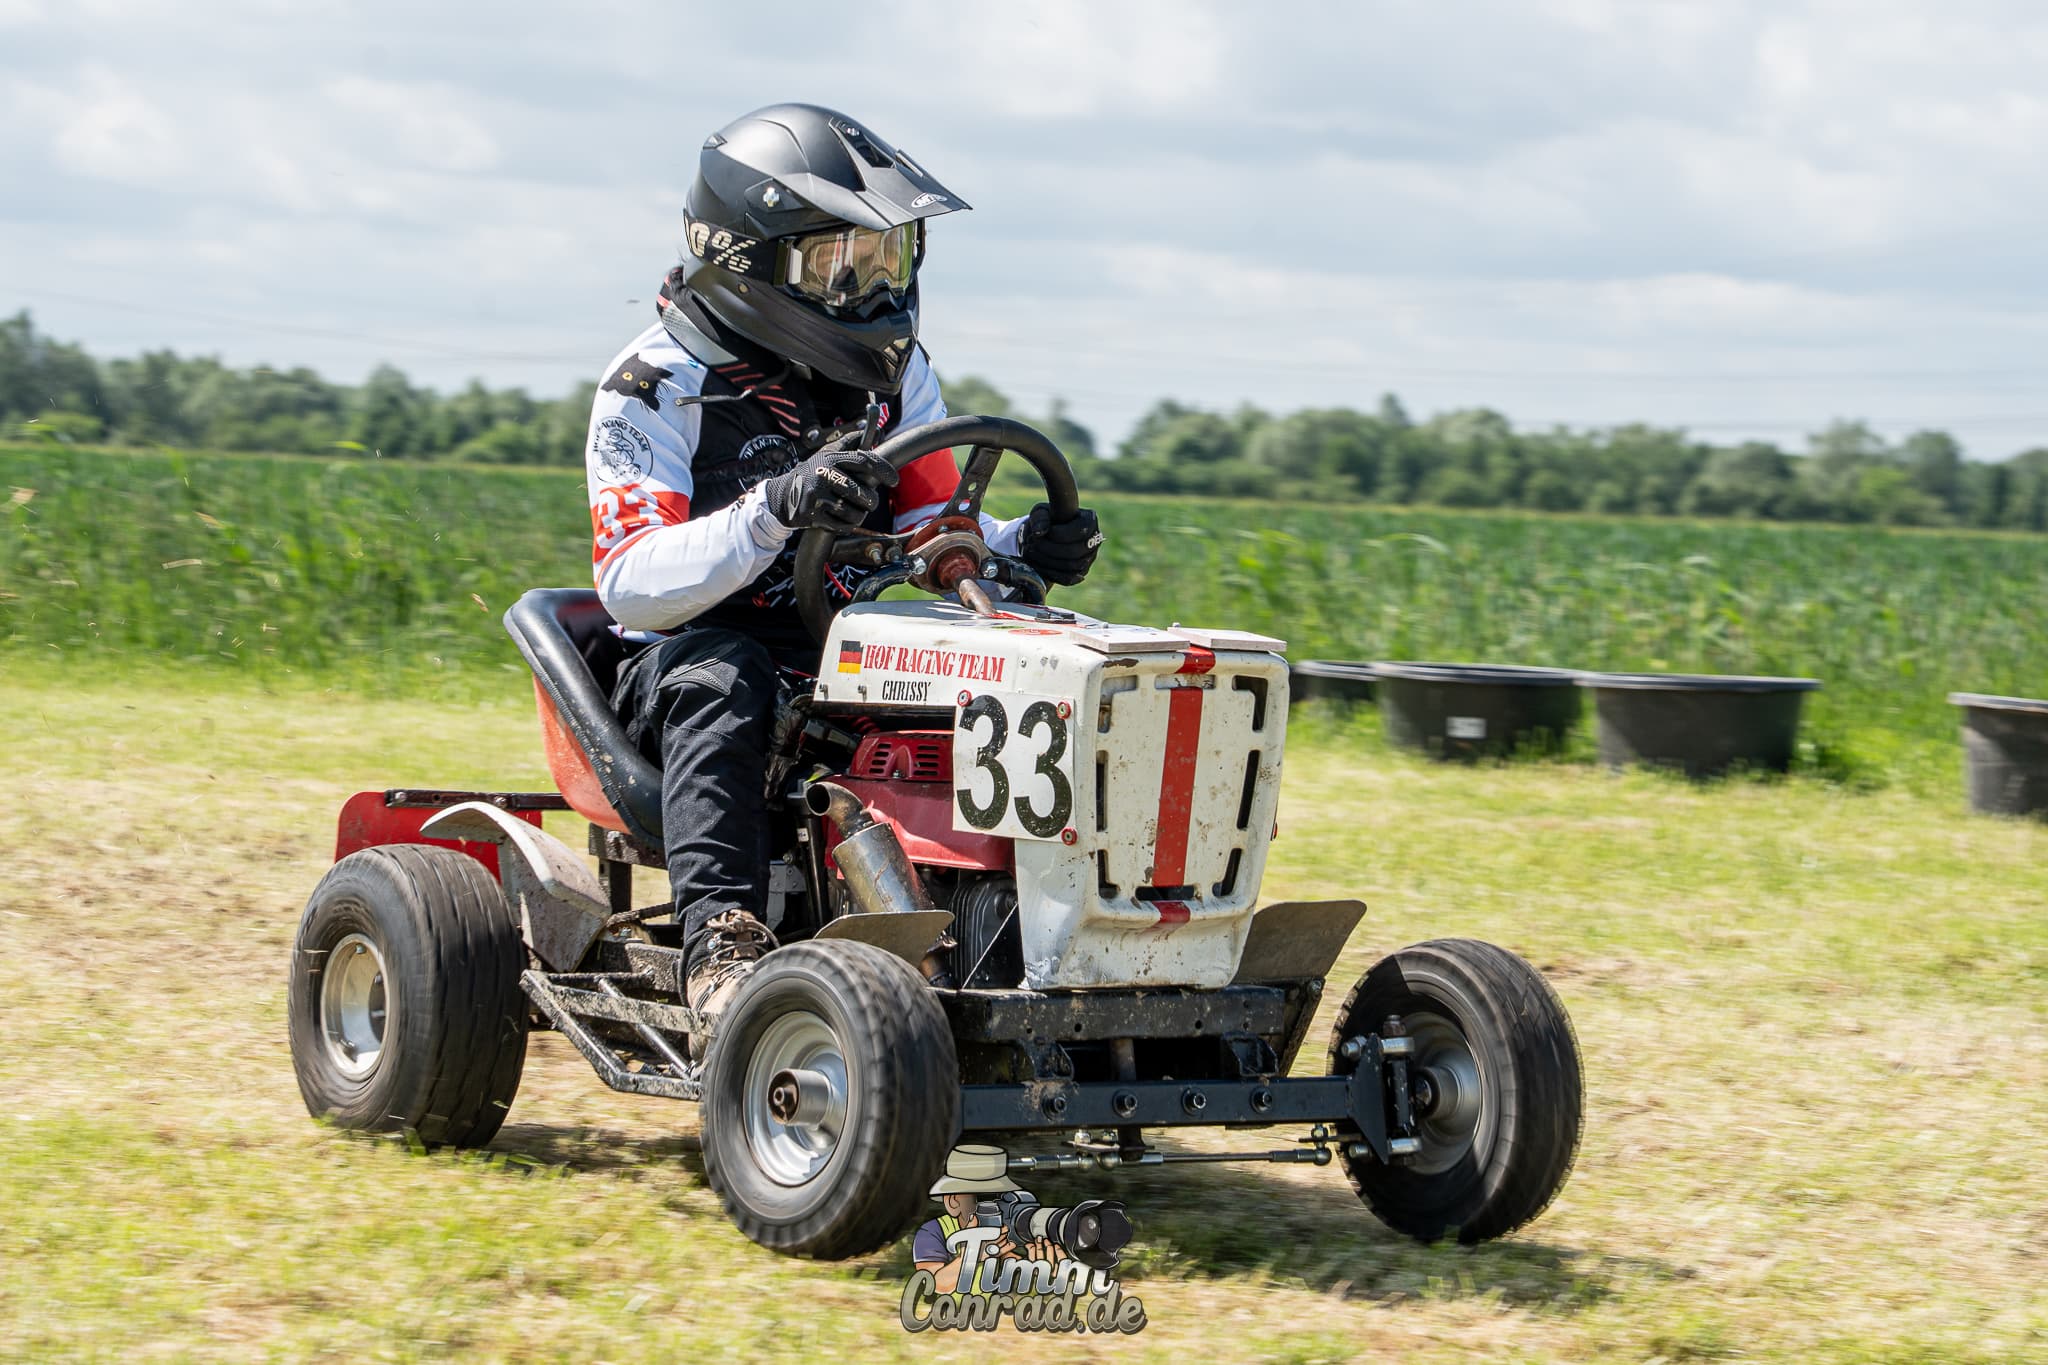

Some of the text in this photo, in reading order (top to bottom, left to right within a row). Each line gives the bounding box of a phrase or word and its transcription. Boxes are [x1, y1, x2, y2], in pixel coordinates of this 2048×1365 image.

[596, 487, 664, 549] 33
[863, 644, 1006, 683] HOF RACING TEAM
[882, 680, 931, 702] CHRISSY
[956, 694, 1073, 838] 33
